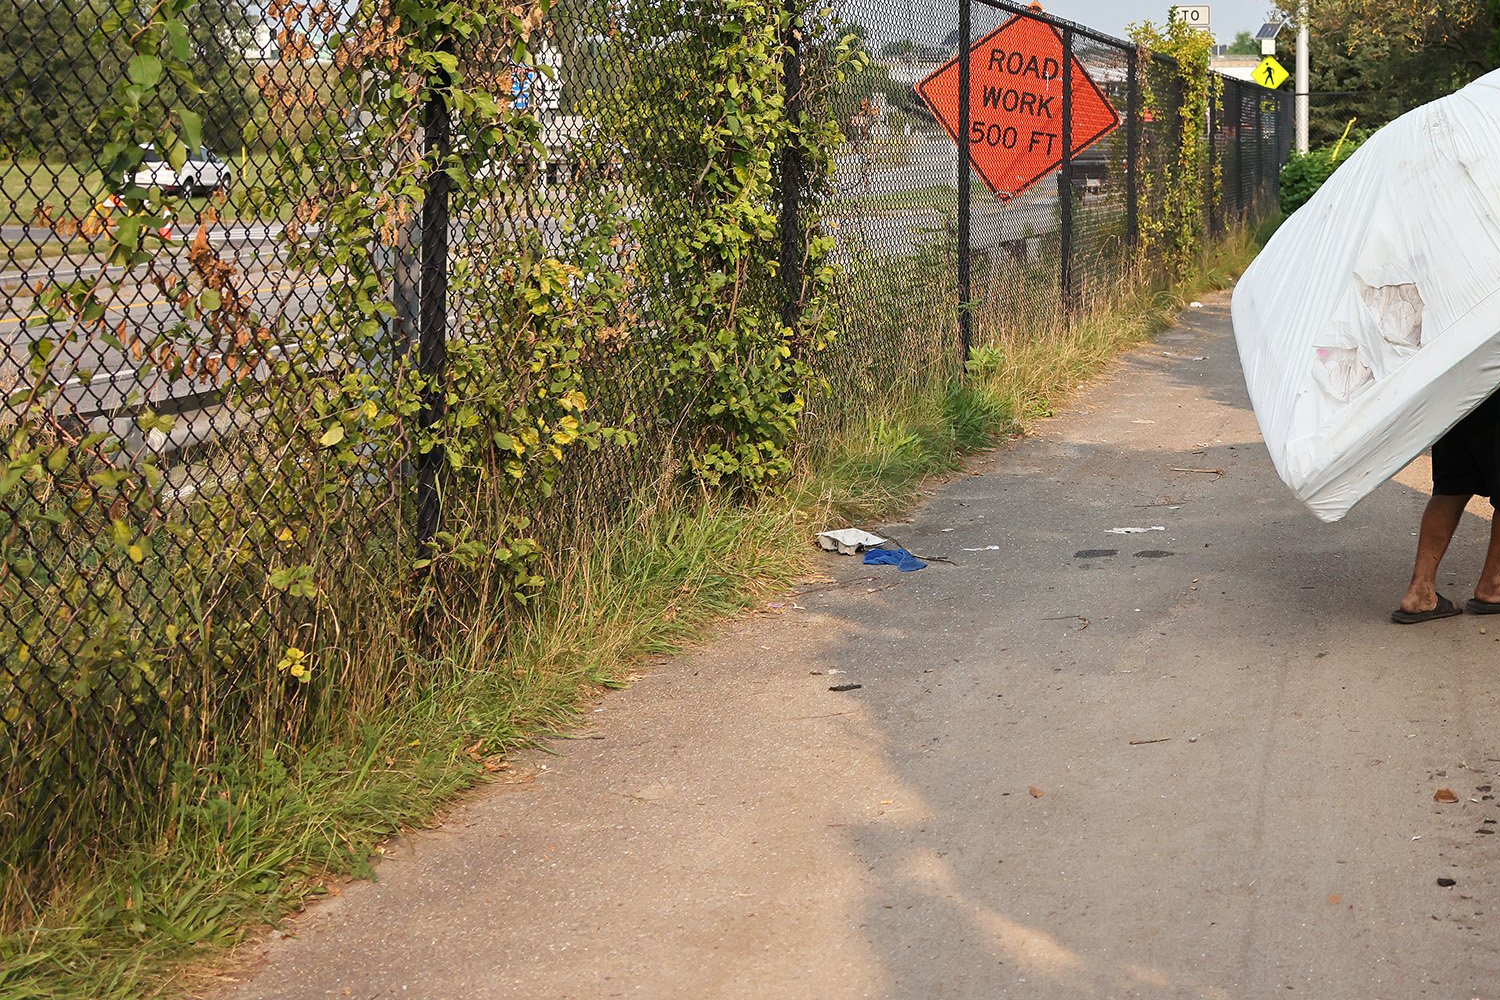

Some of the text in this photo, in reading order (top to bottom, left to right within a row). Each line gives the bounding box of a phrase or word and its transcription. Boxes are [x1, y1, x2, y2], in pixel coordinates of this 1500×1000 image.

[1181, 9, 1200, 21] TO
[988, 48, 1059, 81] ROAD
[982, 84, 1056, 119] WORK
[970, 121, 1057, 156] 500 FT
